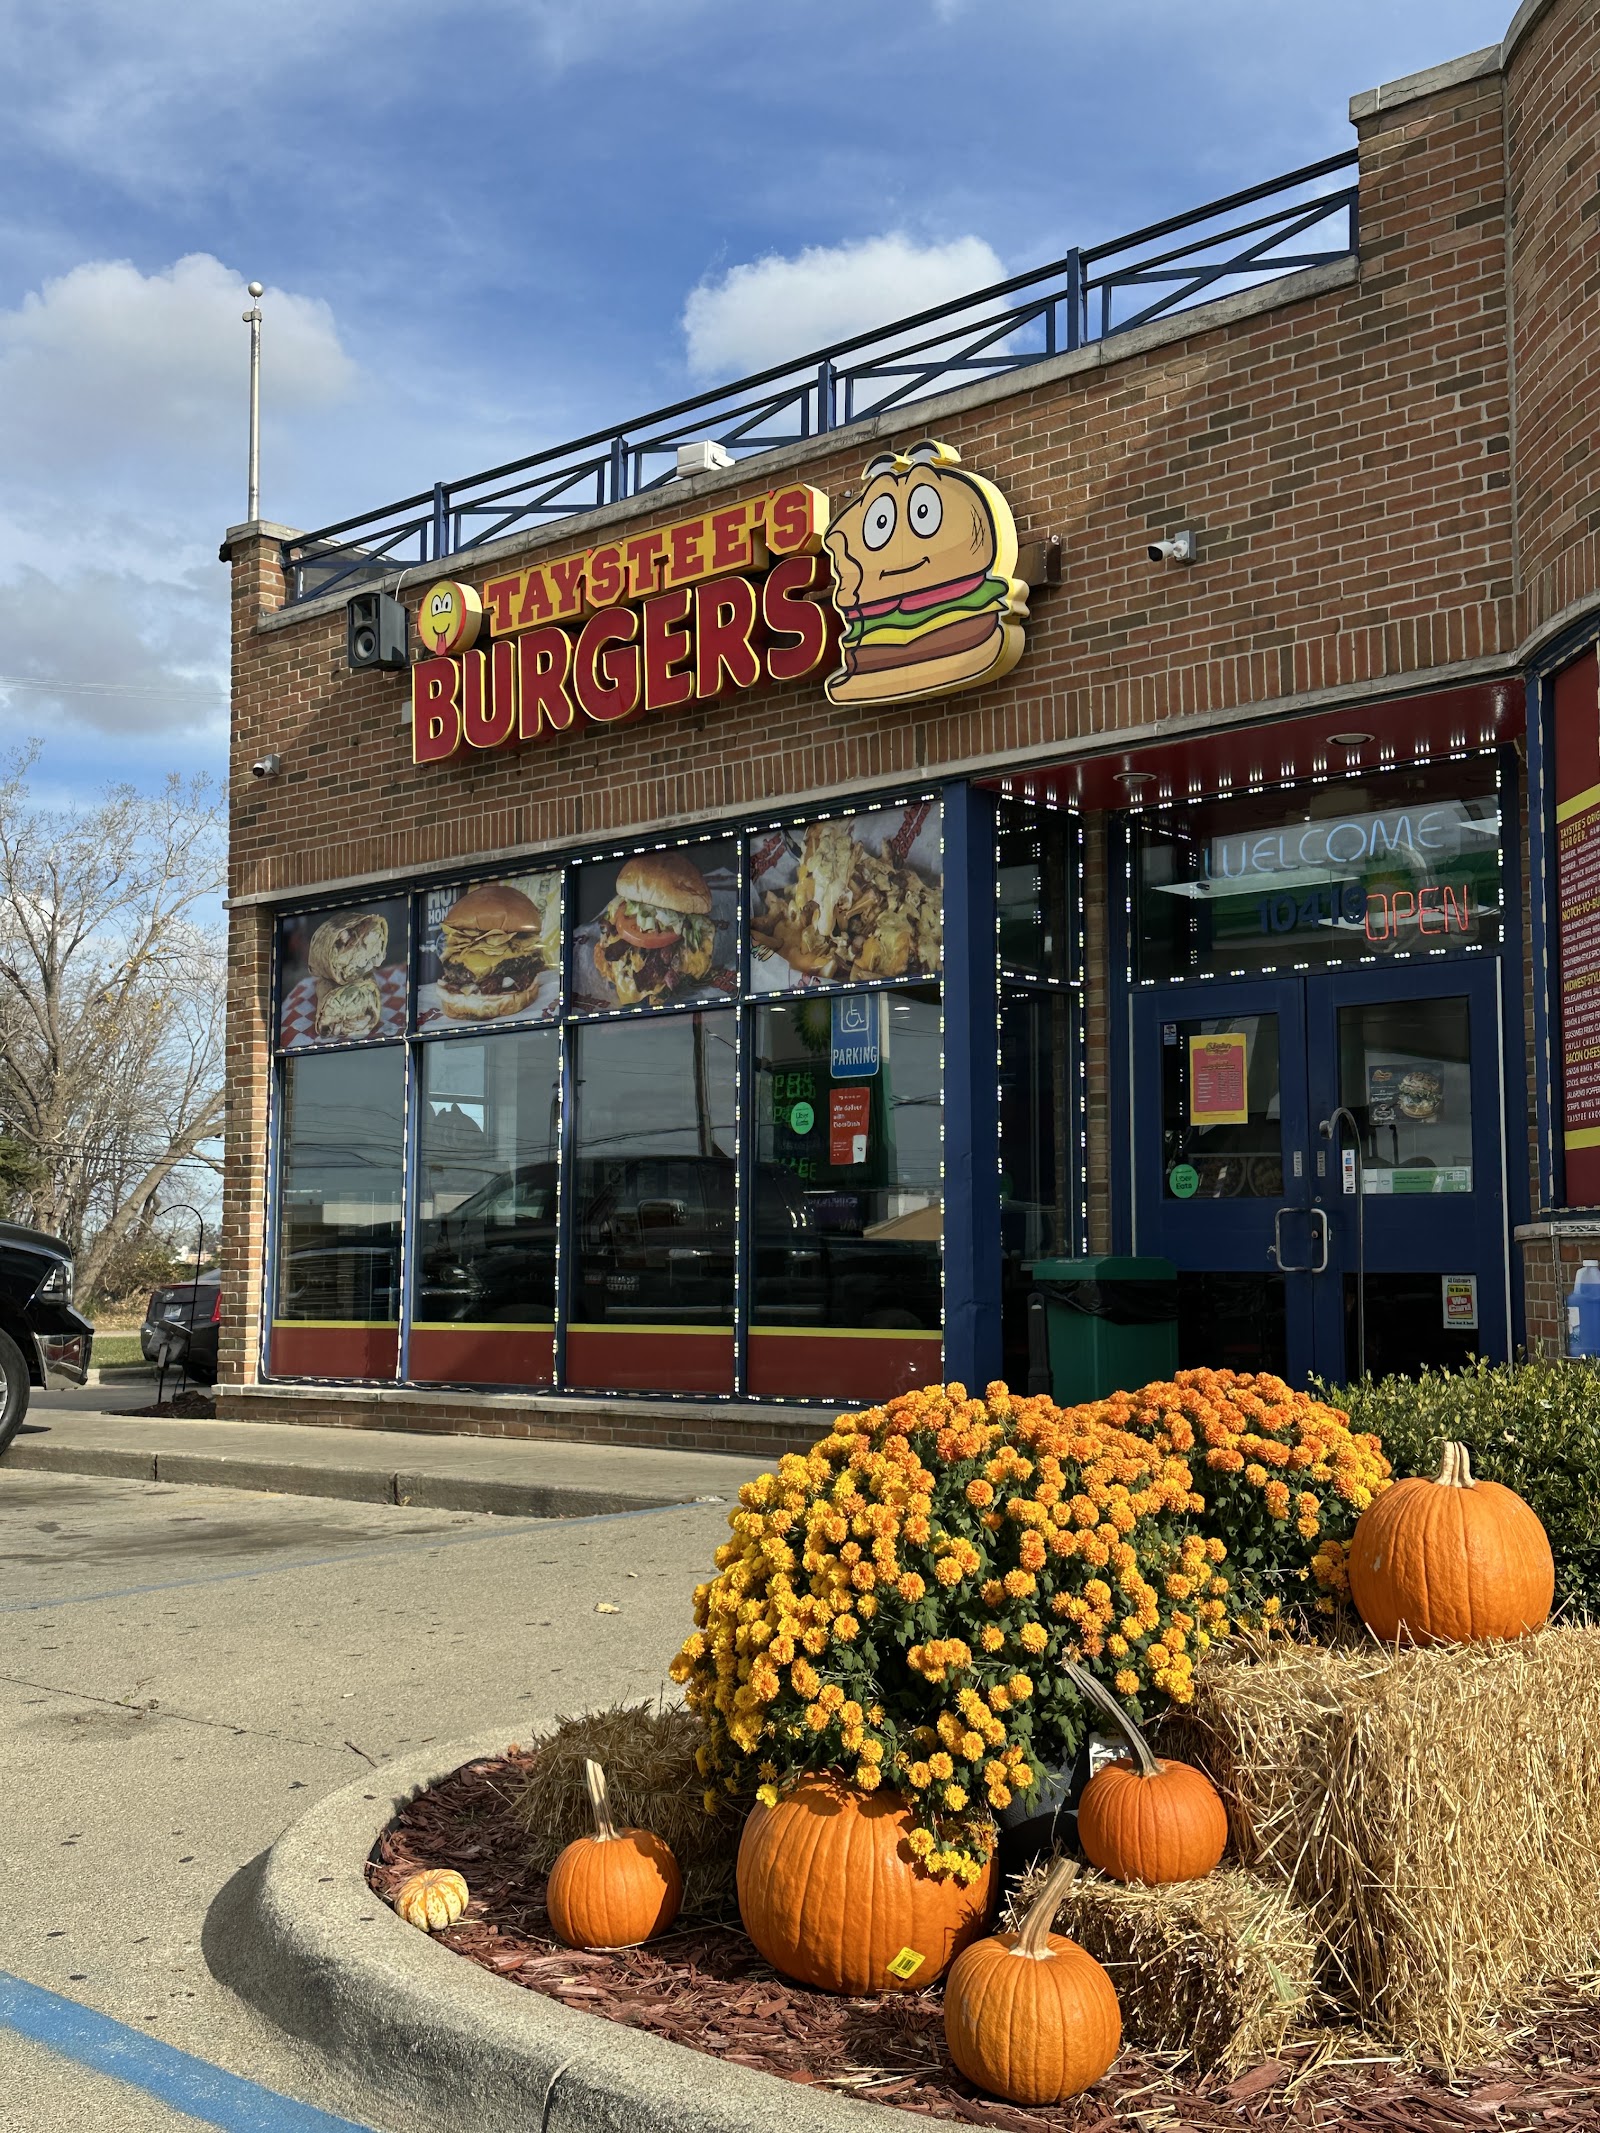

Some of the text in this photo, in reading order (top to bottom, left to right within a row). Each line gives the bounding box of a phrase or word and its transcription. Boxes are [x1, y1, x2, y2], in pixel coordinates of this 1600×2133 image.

[485, 484, 828, 637] TAYSTEE'S
[412, 556, 828, 765] BURGERS
[1204, 811, 1445, 881] WELCOME
[1364, 884, 1469, 941] OPEN
[833, 1047, 878, 1067] PARKING
